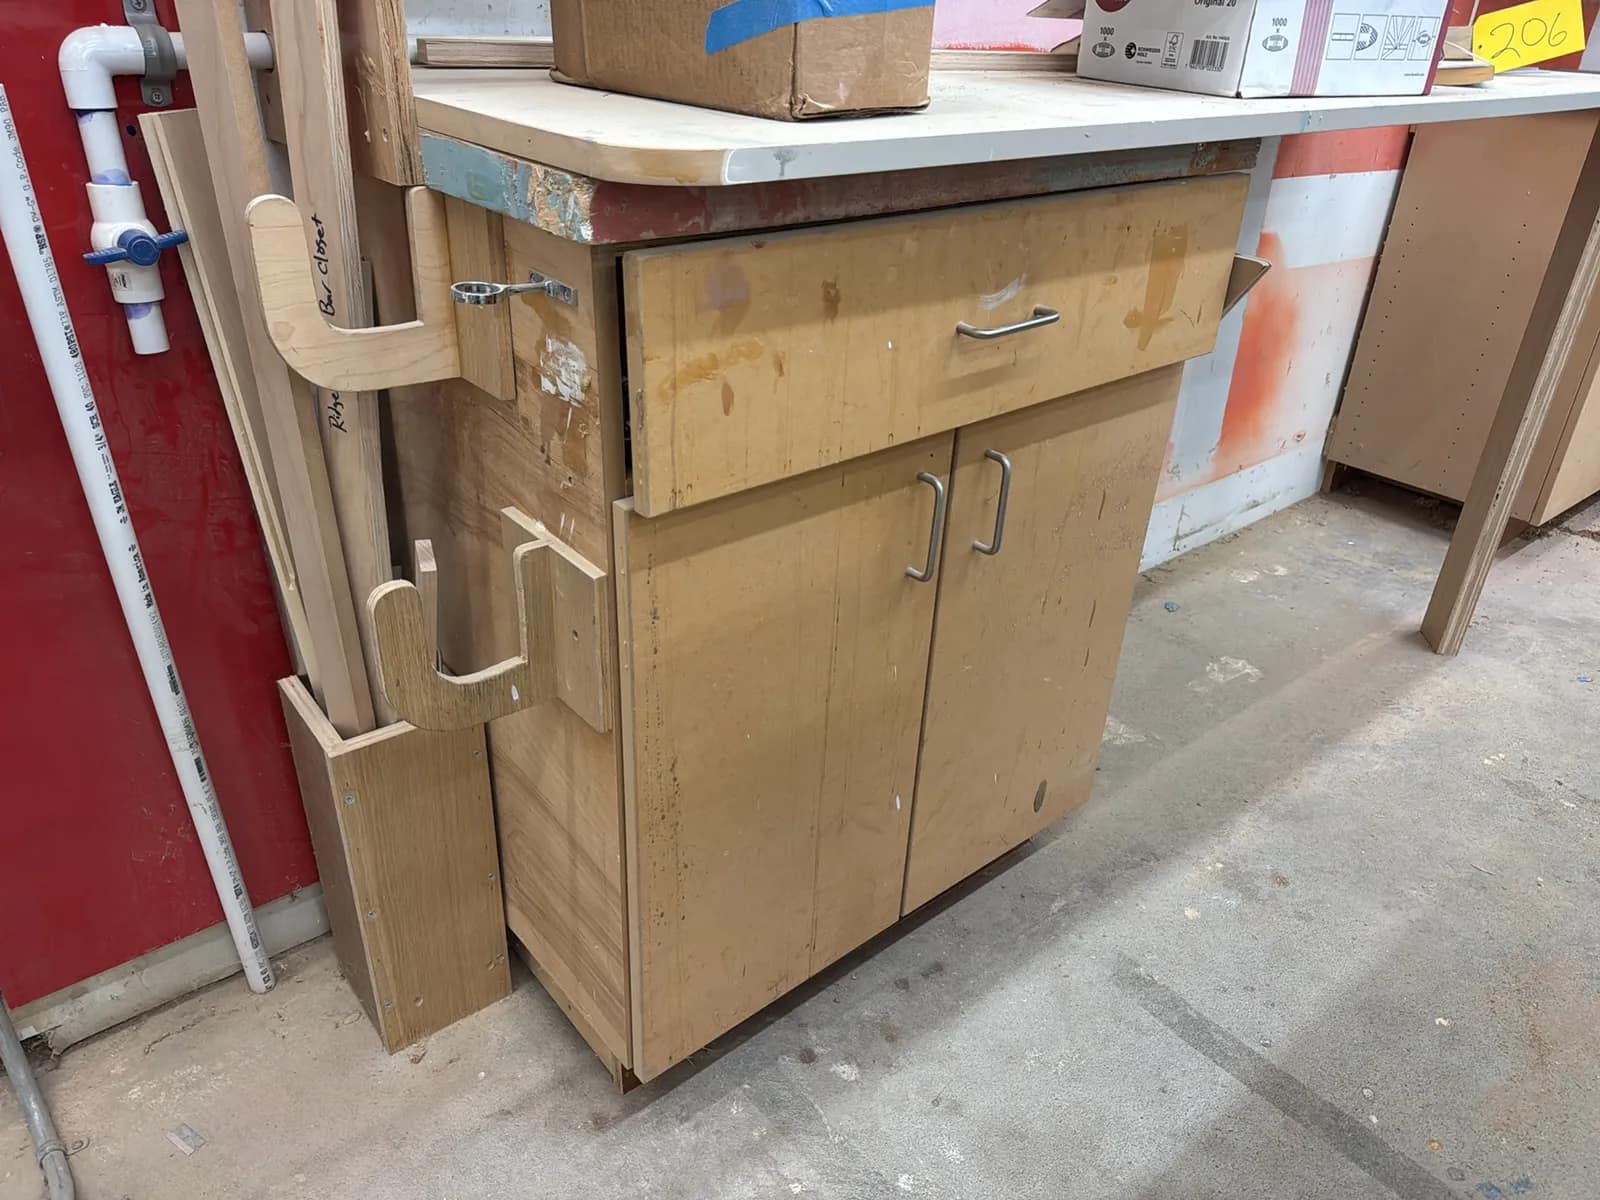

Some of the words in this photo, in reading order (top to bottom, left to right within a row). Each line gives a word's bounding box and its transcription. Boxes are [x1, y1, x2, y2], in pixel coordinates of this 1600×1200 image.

[1100, 26, 1115, 36] 1000
[1272, 17, 1288, 27] 1000
[1490, 12, 1567, 59] 206
[312, 213, 329, 275] Closet
[319, 280, 335, 316] Bar
[73, 361, 85, 381] 1120
[84, 401, 95, 411] 40
[327, 391, 347, 433] Ridge
[130, 552, 145, 582] America
